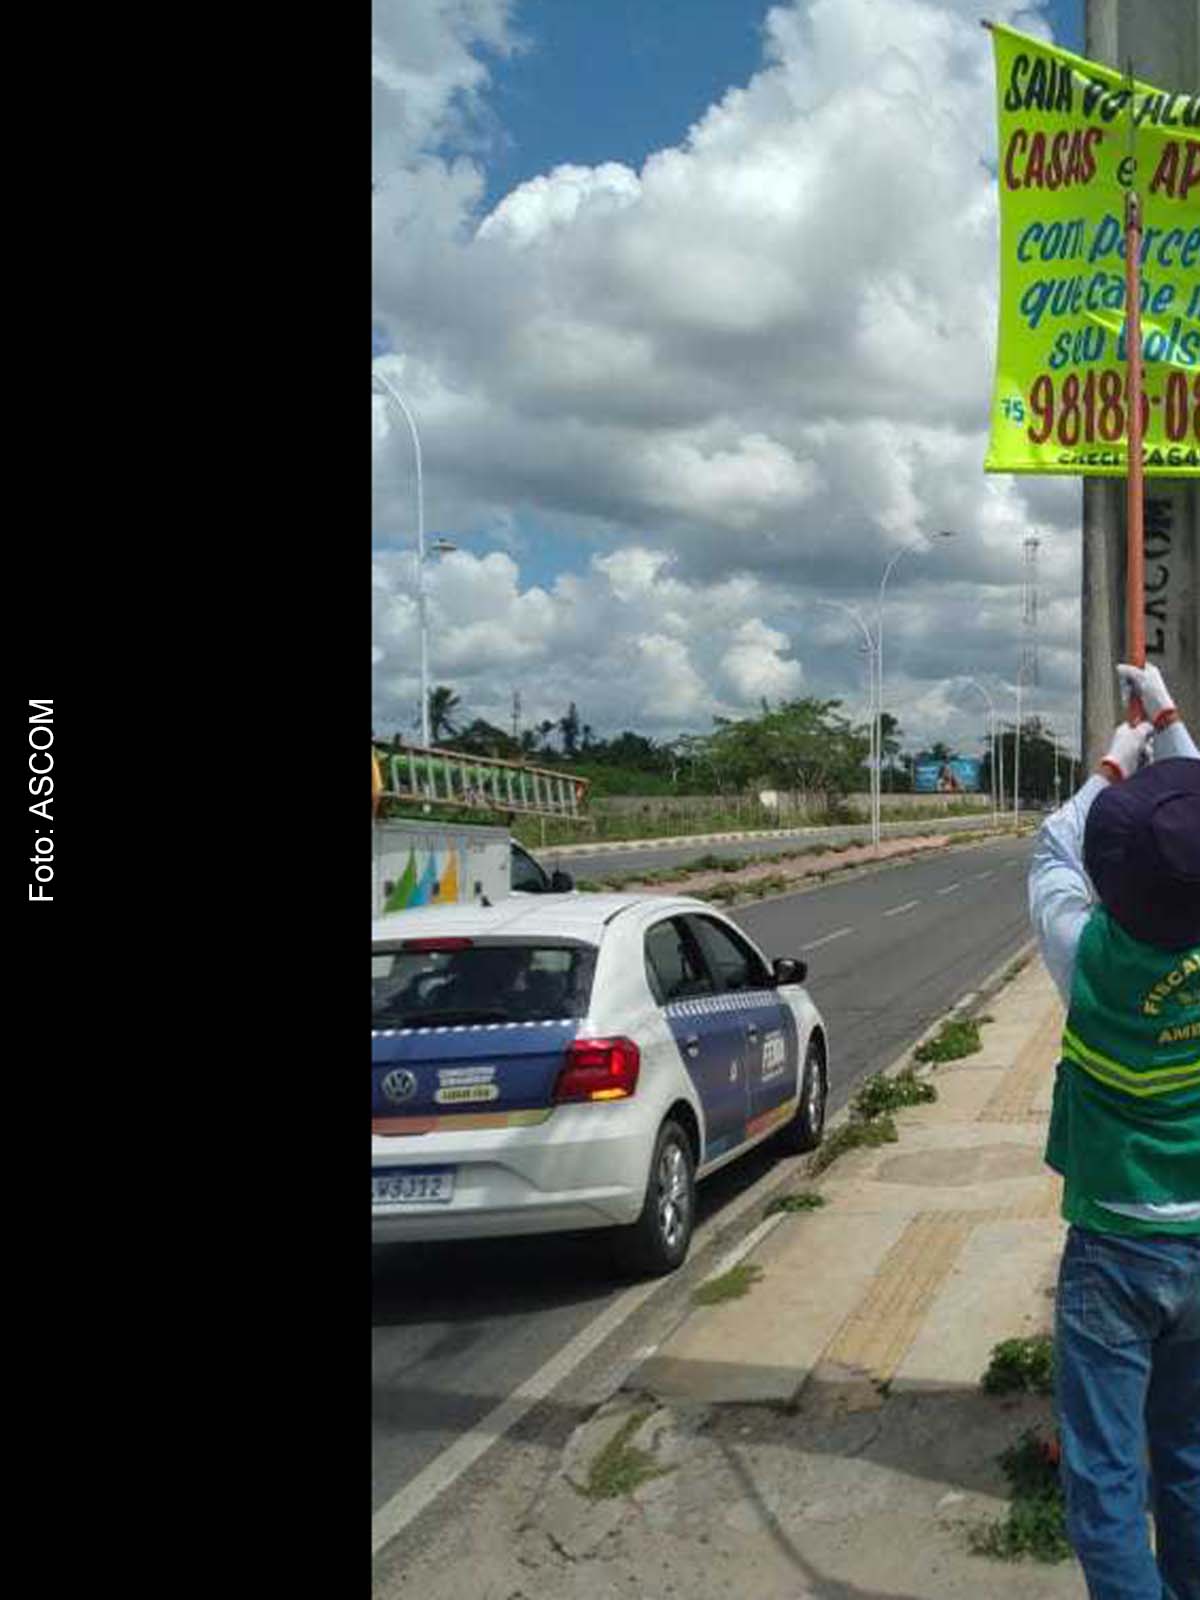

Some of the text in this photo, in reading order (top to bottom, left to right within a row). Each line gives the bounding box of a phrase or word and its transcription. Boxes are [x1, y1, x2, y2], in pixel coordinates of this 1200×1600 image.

[1005, 53, 1073, 113] SAIA
[1005, 127, 1104, 191] CASAS
[1117, 156, 1138, 187] e
[1017, 218, 1085, 263] com
